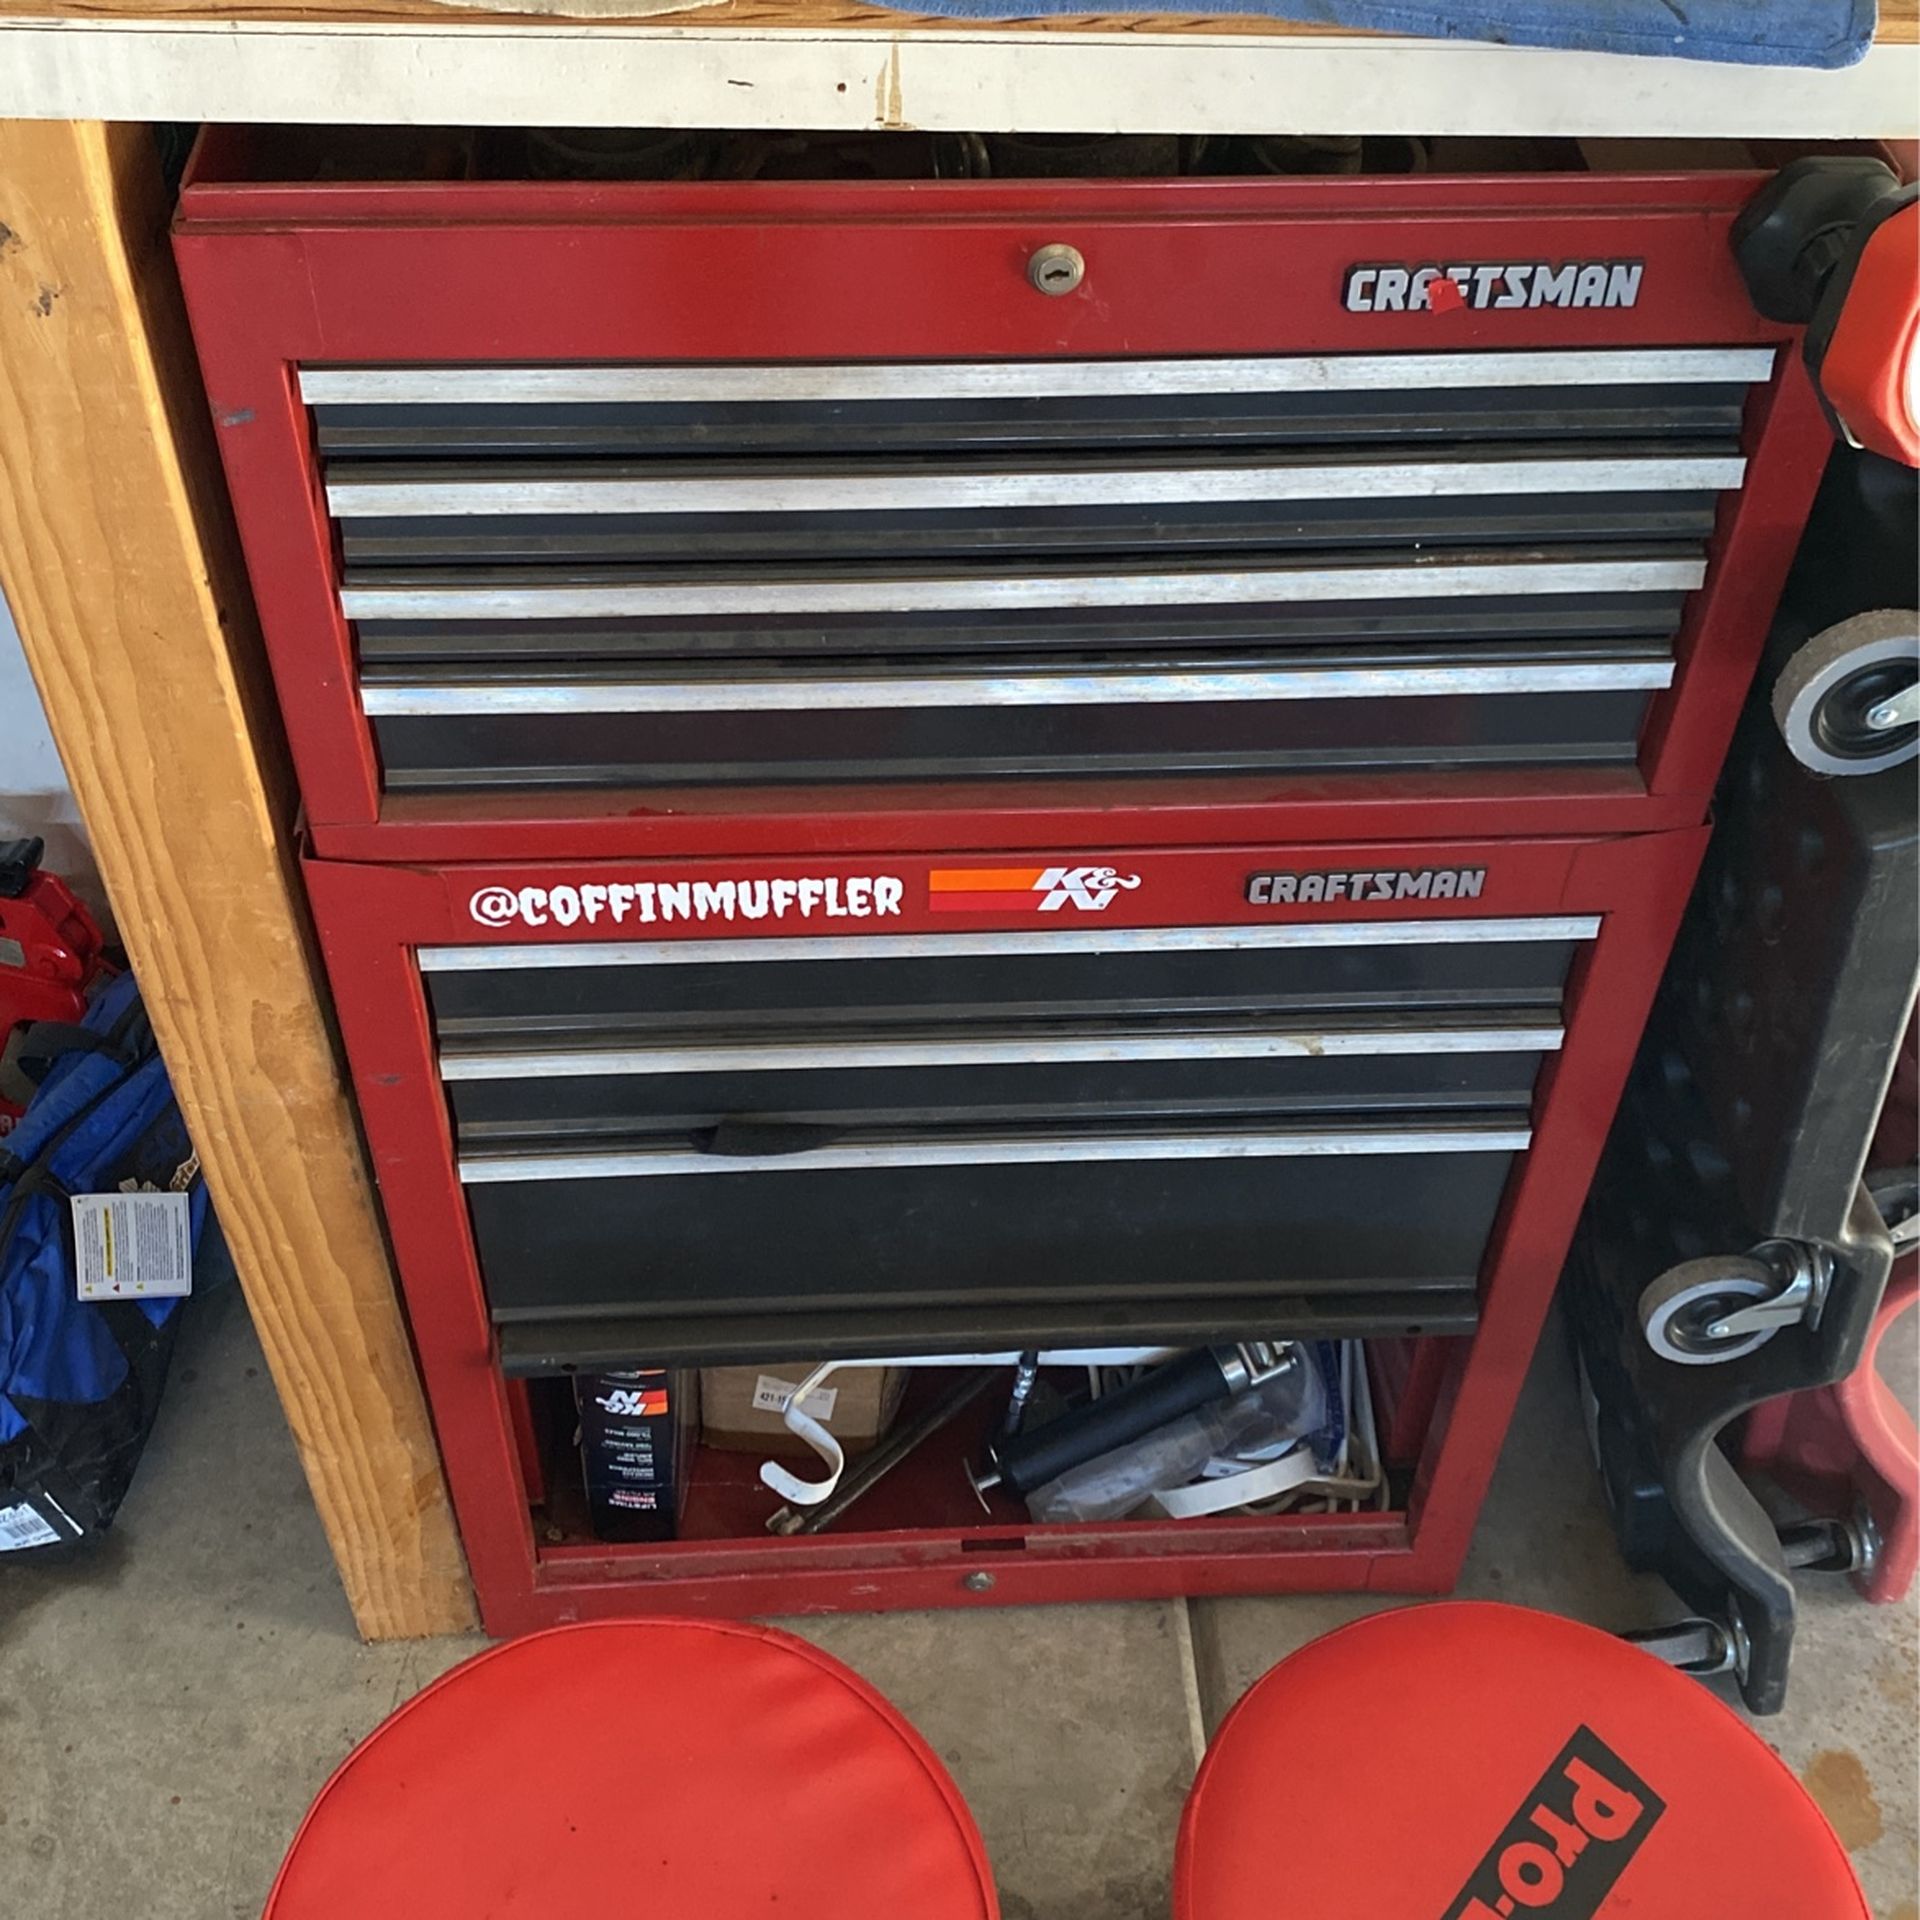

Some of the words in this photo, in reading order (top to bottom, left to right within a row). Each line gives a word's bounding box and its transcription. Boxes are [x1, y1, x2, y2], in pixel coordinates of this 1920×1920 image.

[469, 876, 904, 927] @COFFINMUFFLER
[1031, 866, 1142, 911] K&N
[1248, 869, 1486, 905] CRAFTSMAN
